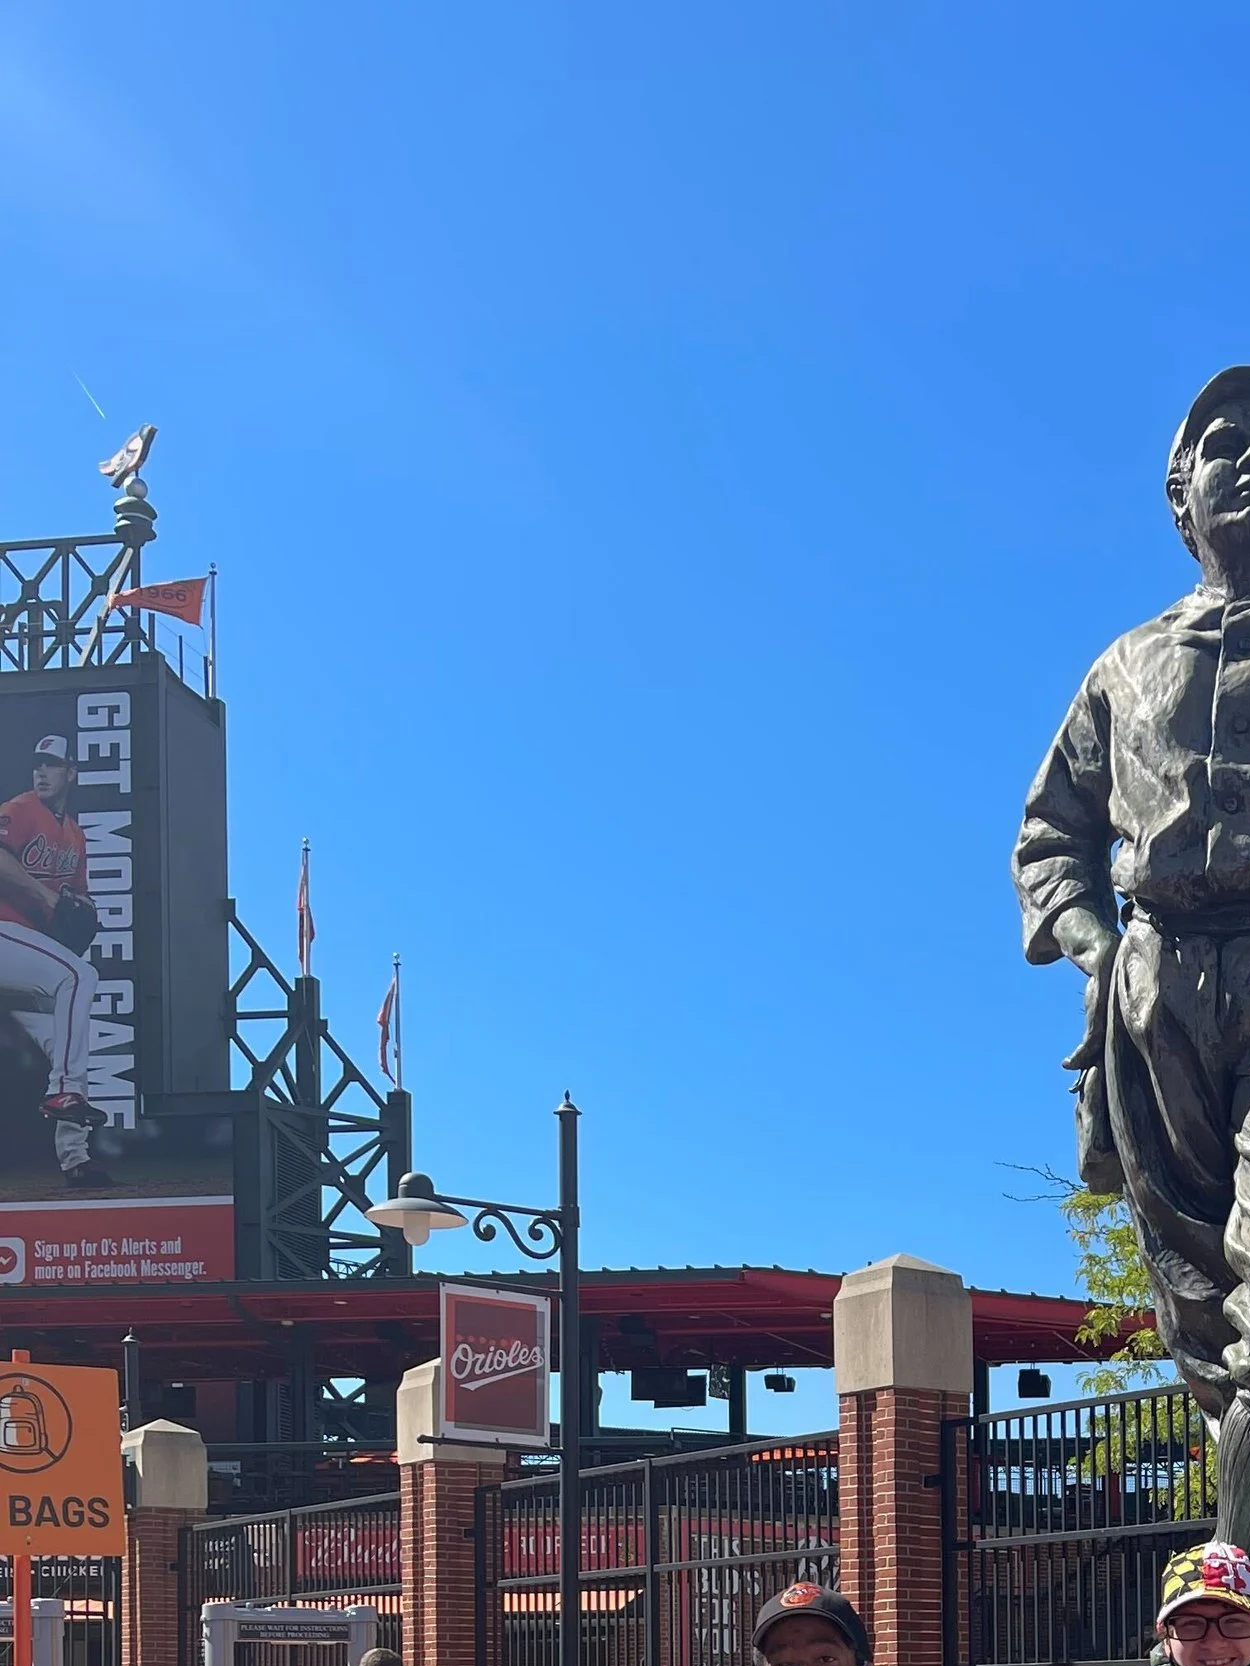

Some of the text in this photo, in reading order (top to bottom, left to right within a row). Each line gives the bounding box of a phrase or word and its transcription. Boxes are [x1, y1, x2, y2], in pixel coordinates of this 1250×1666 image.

[77, 691, 136, 1129] GET MORE GAME
[34, 1236, 182, 1261] Sign up for O's Alerts and
[34, 1259, 207, 1280] more on Facebook Messenger.
[450, 1340, 546, 1391] Orioles
[8, 1494, 111, 1529] BAGS
[240, 1624, 266, 1632] PLEASE
[286, 1624, 300, 1632] FOR
